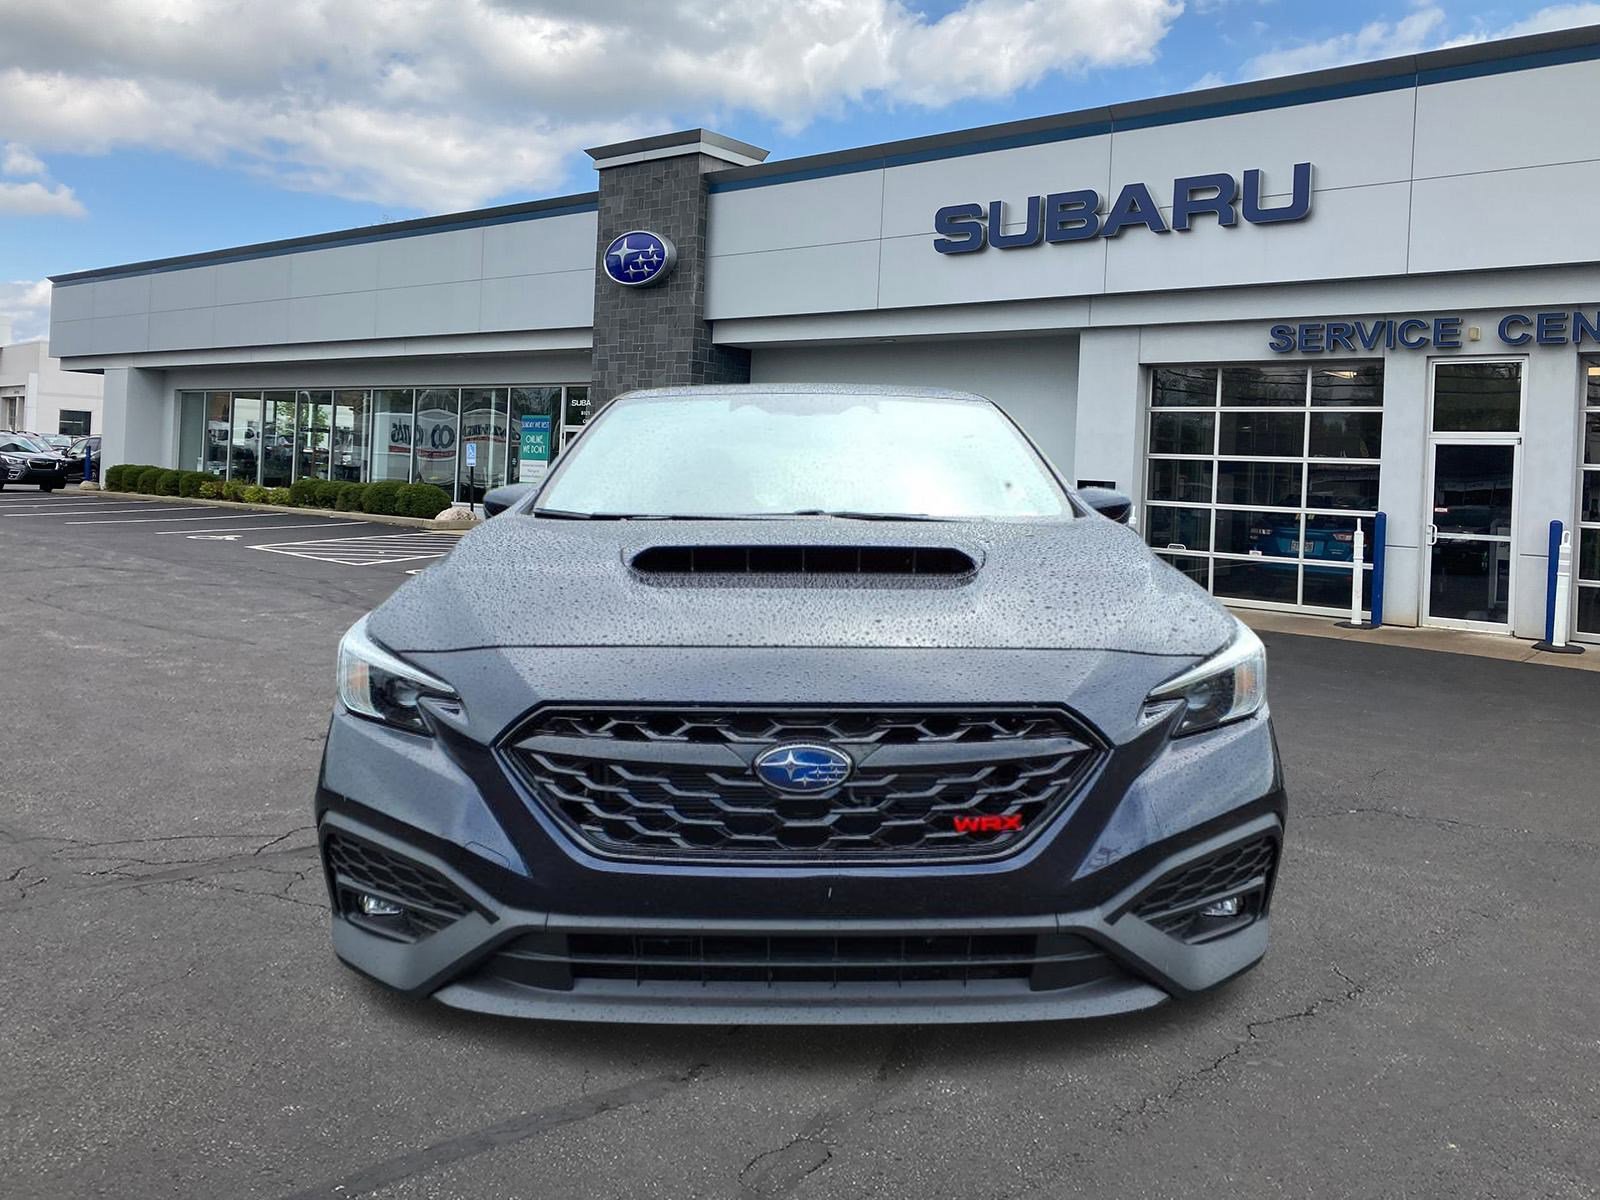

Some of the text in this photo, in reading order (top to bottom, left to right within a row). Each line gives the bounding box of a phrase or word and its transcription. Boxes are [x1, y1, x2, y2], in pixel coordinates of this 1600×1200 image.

[933, 161, 1314, 255] SUBARU
[1269, 309, 1600, 353] SERVICE CEN
[571, 399, 591, 407] SUBA
[525, 434, 544, 444] ONLINE
[523, 445, 530, 453] WE
[953, 814, 1022, 833] WRX
